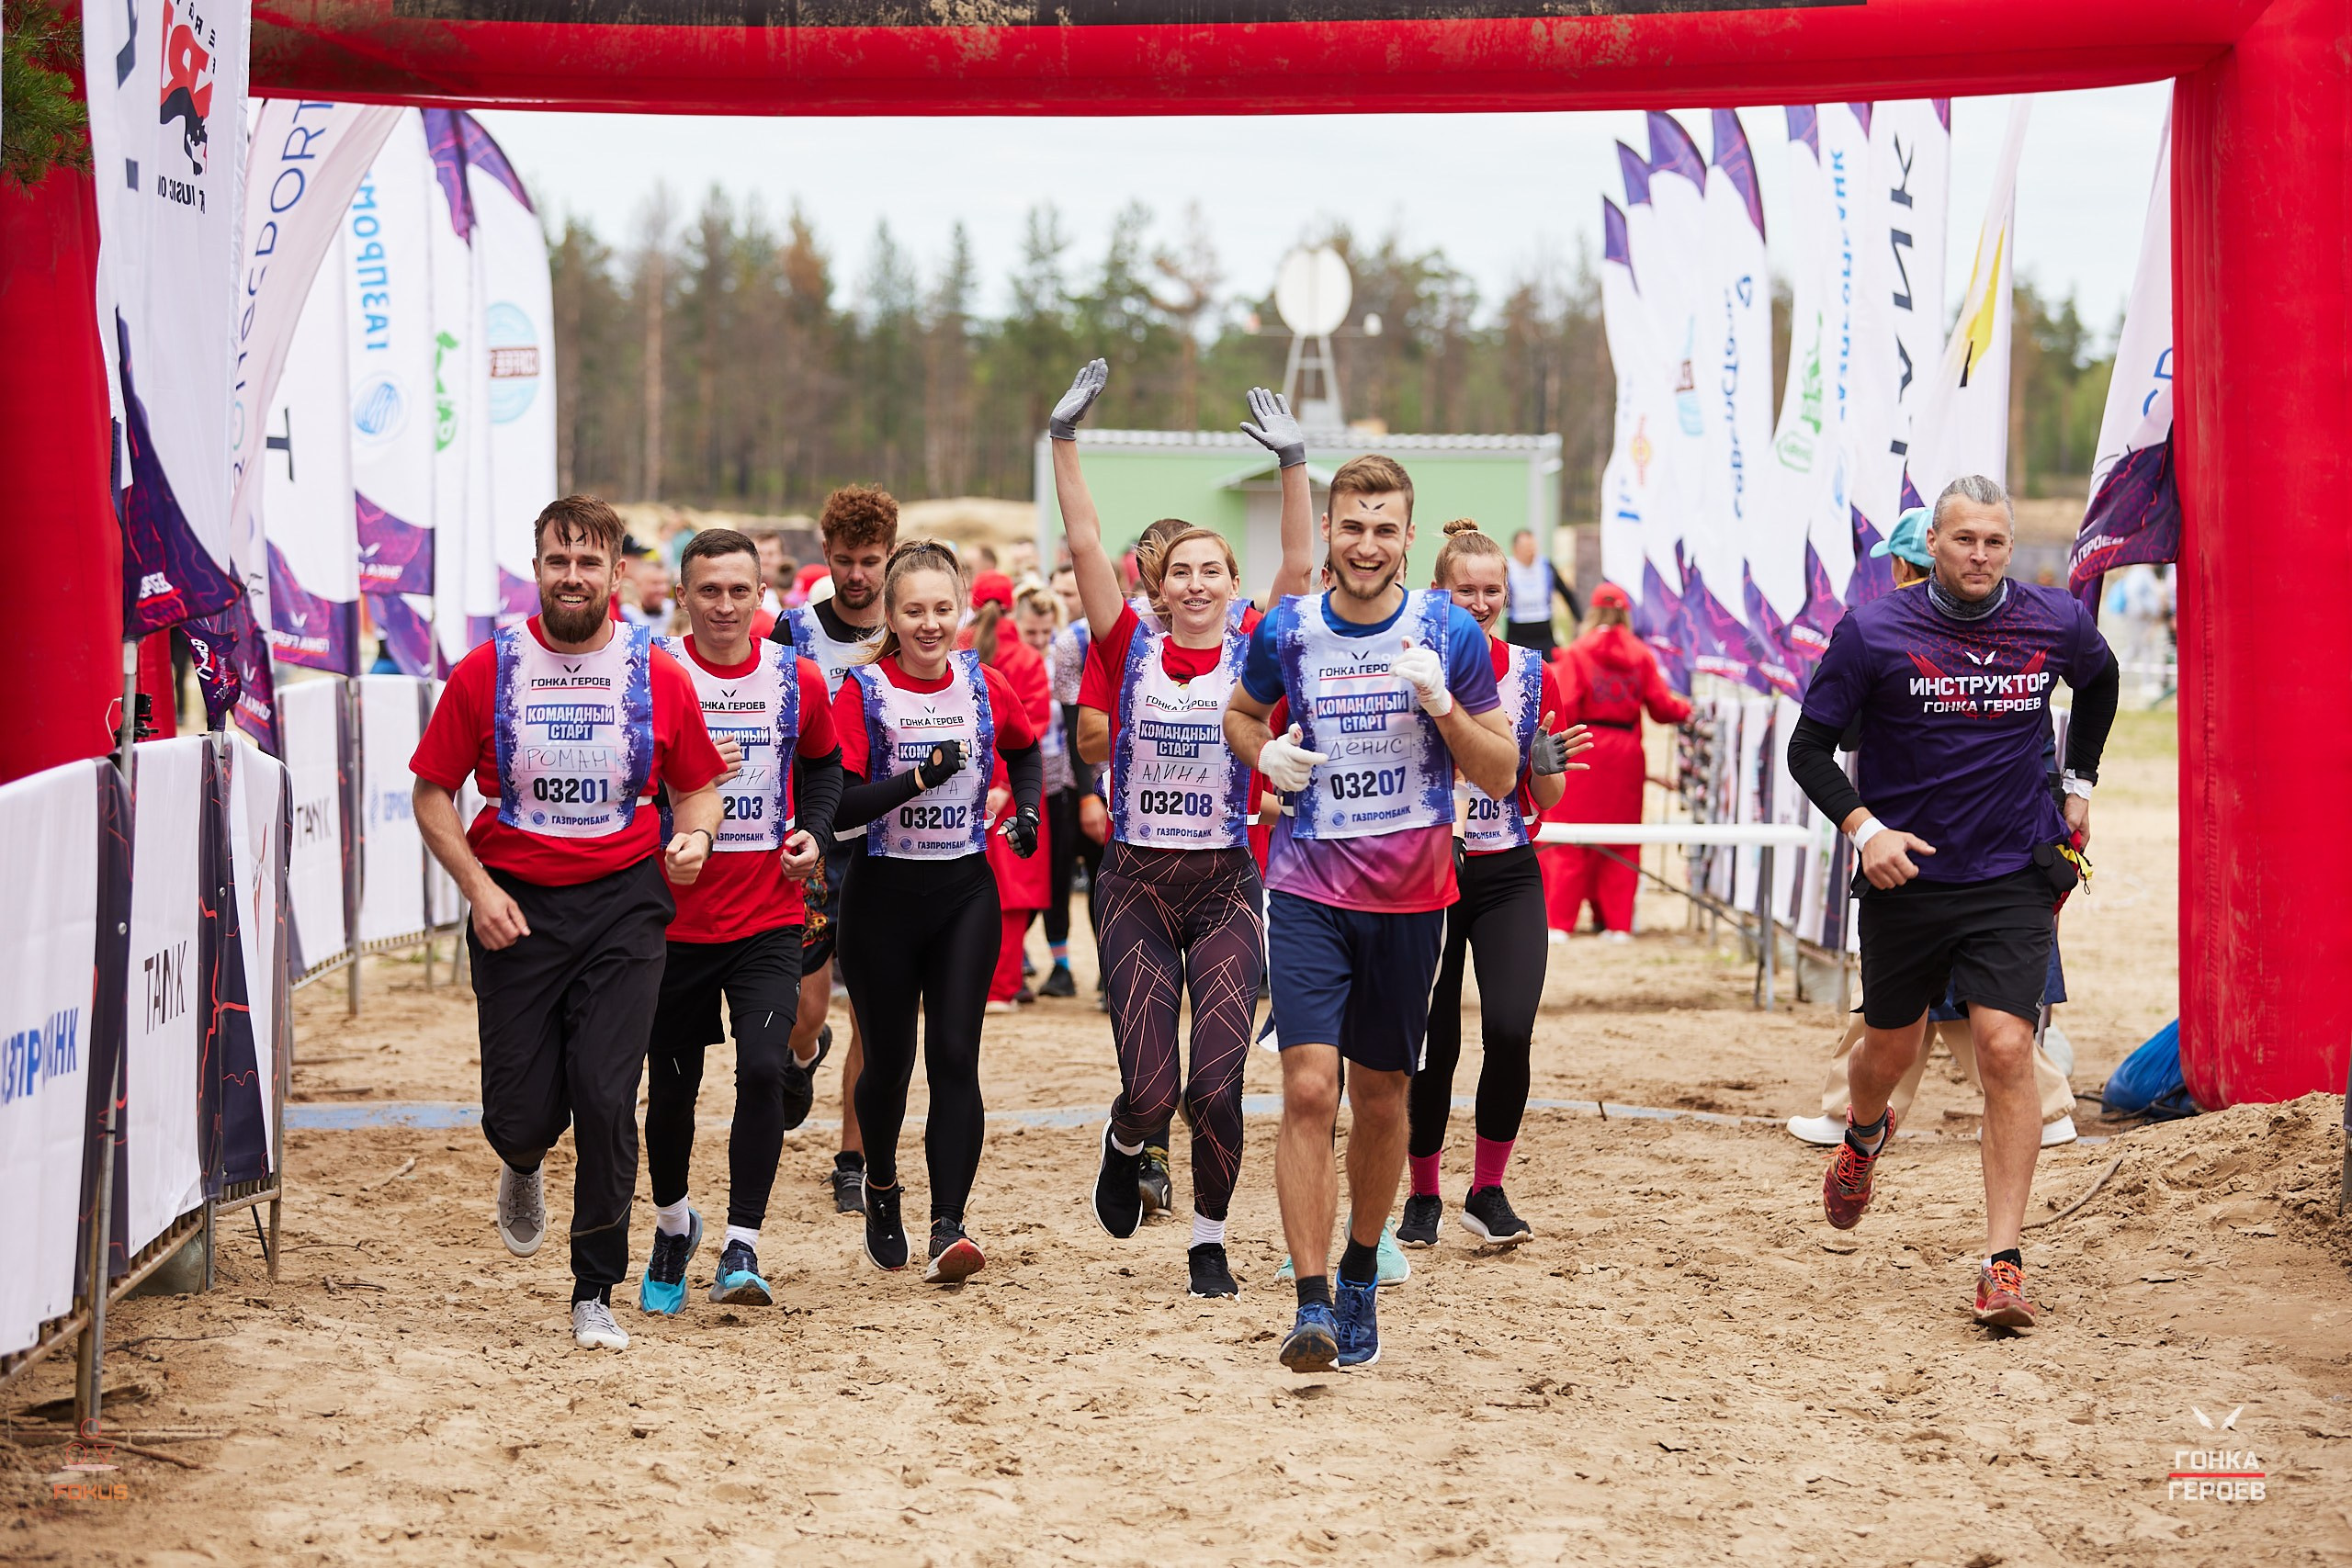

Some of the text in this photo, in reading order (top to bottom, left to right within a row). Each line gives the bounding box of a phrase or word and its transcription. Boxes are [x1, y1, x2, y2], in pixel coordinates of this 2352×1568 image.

[1319, 663, 1391, 677] ГОНКА ГЕРО
[531, 677, 611, 687] ГОНКА ГЕРОЕВ
[1909, 671, 2050, 696] ИНСТРУКТОР
[700, 701, 766, 710] ОНКА ГЕРОЕВ
[1146, 695, 1217, 711] ГОНКА ГЕРОЕВ
[1317, 691, 1407, 716] КОМАНДНЫЙ
[1924, 697, 2041, 713] ГОНКА ГЕРОЕВ
[527, 705, 614, 724] КОМАНДНЫЙ
[900, 716, 964, 727] ГОНКА ГЕРОЕВ
[1342, 715, 1385, 732] СТАРТ
[550, 724, 591, 739] СТАРТ
[1140, 722, 1219, 743] КОМАНДНЫЙ
[1159, 741, 1196, 757] СТАРТ
[527, 748, 608, 772] РОМАН
[1142, 763, 1211, 784] АЛИНА
[534, 777, 608, 804] 03201
[1330, 766, 1406, 801] 03207
[723, 795, 763, 820] 203
[1140, 790, 1213, 818] 03208
[1467, 797, 1500, 820] 205
[551, 814, 610, 826] ГАЗПРОМБАНК
[900, 806, 967, 829] 03202
[1352, 805, 1411, 823] ГАЗПРОМБАНК
[716, 832, 764, 841] АЗПРОМБАНК
[1157, 827, 1212, 838] ГАЗПРОМБАНК
[144, 940, 187, 1035] TANK
